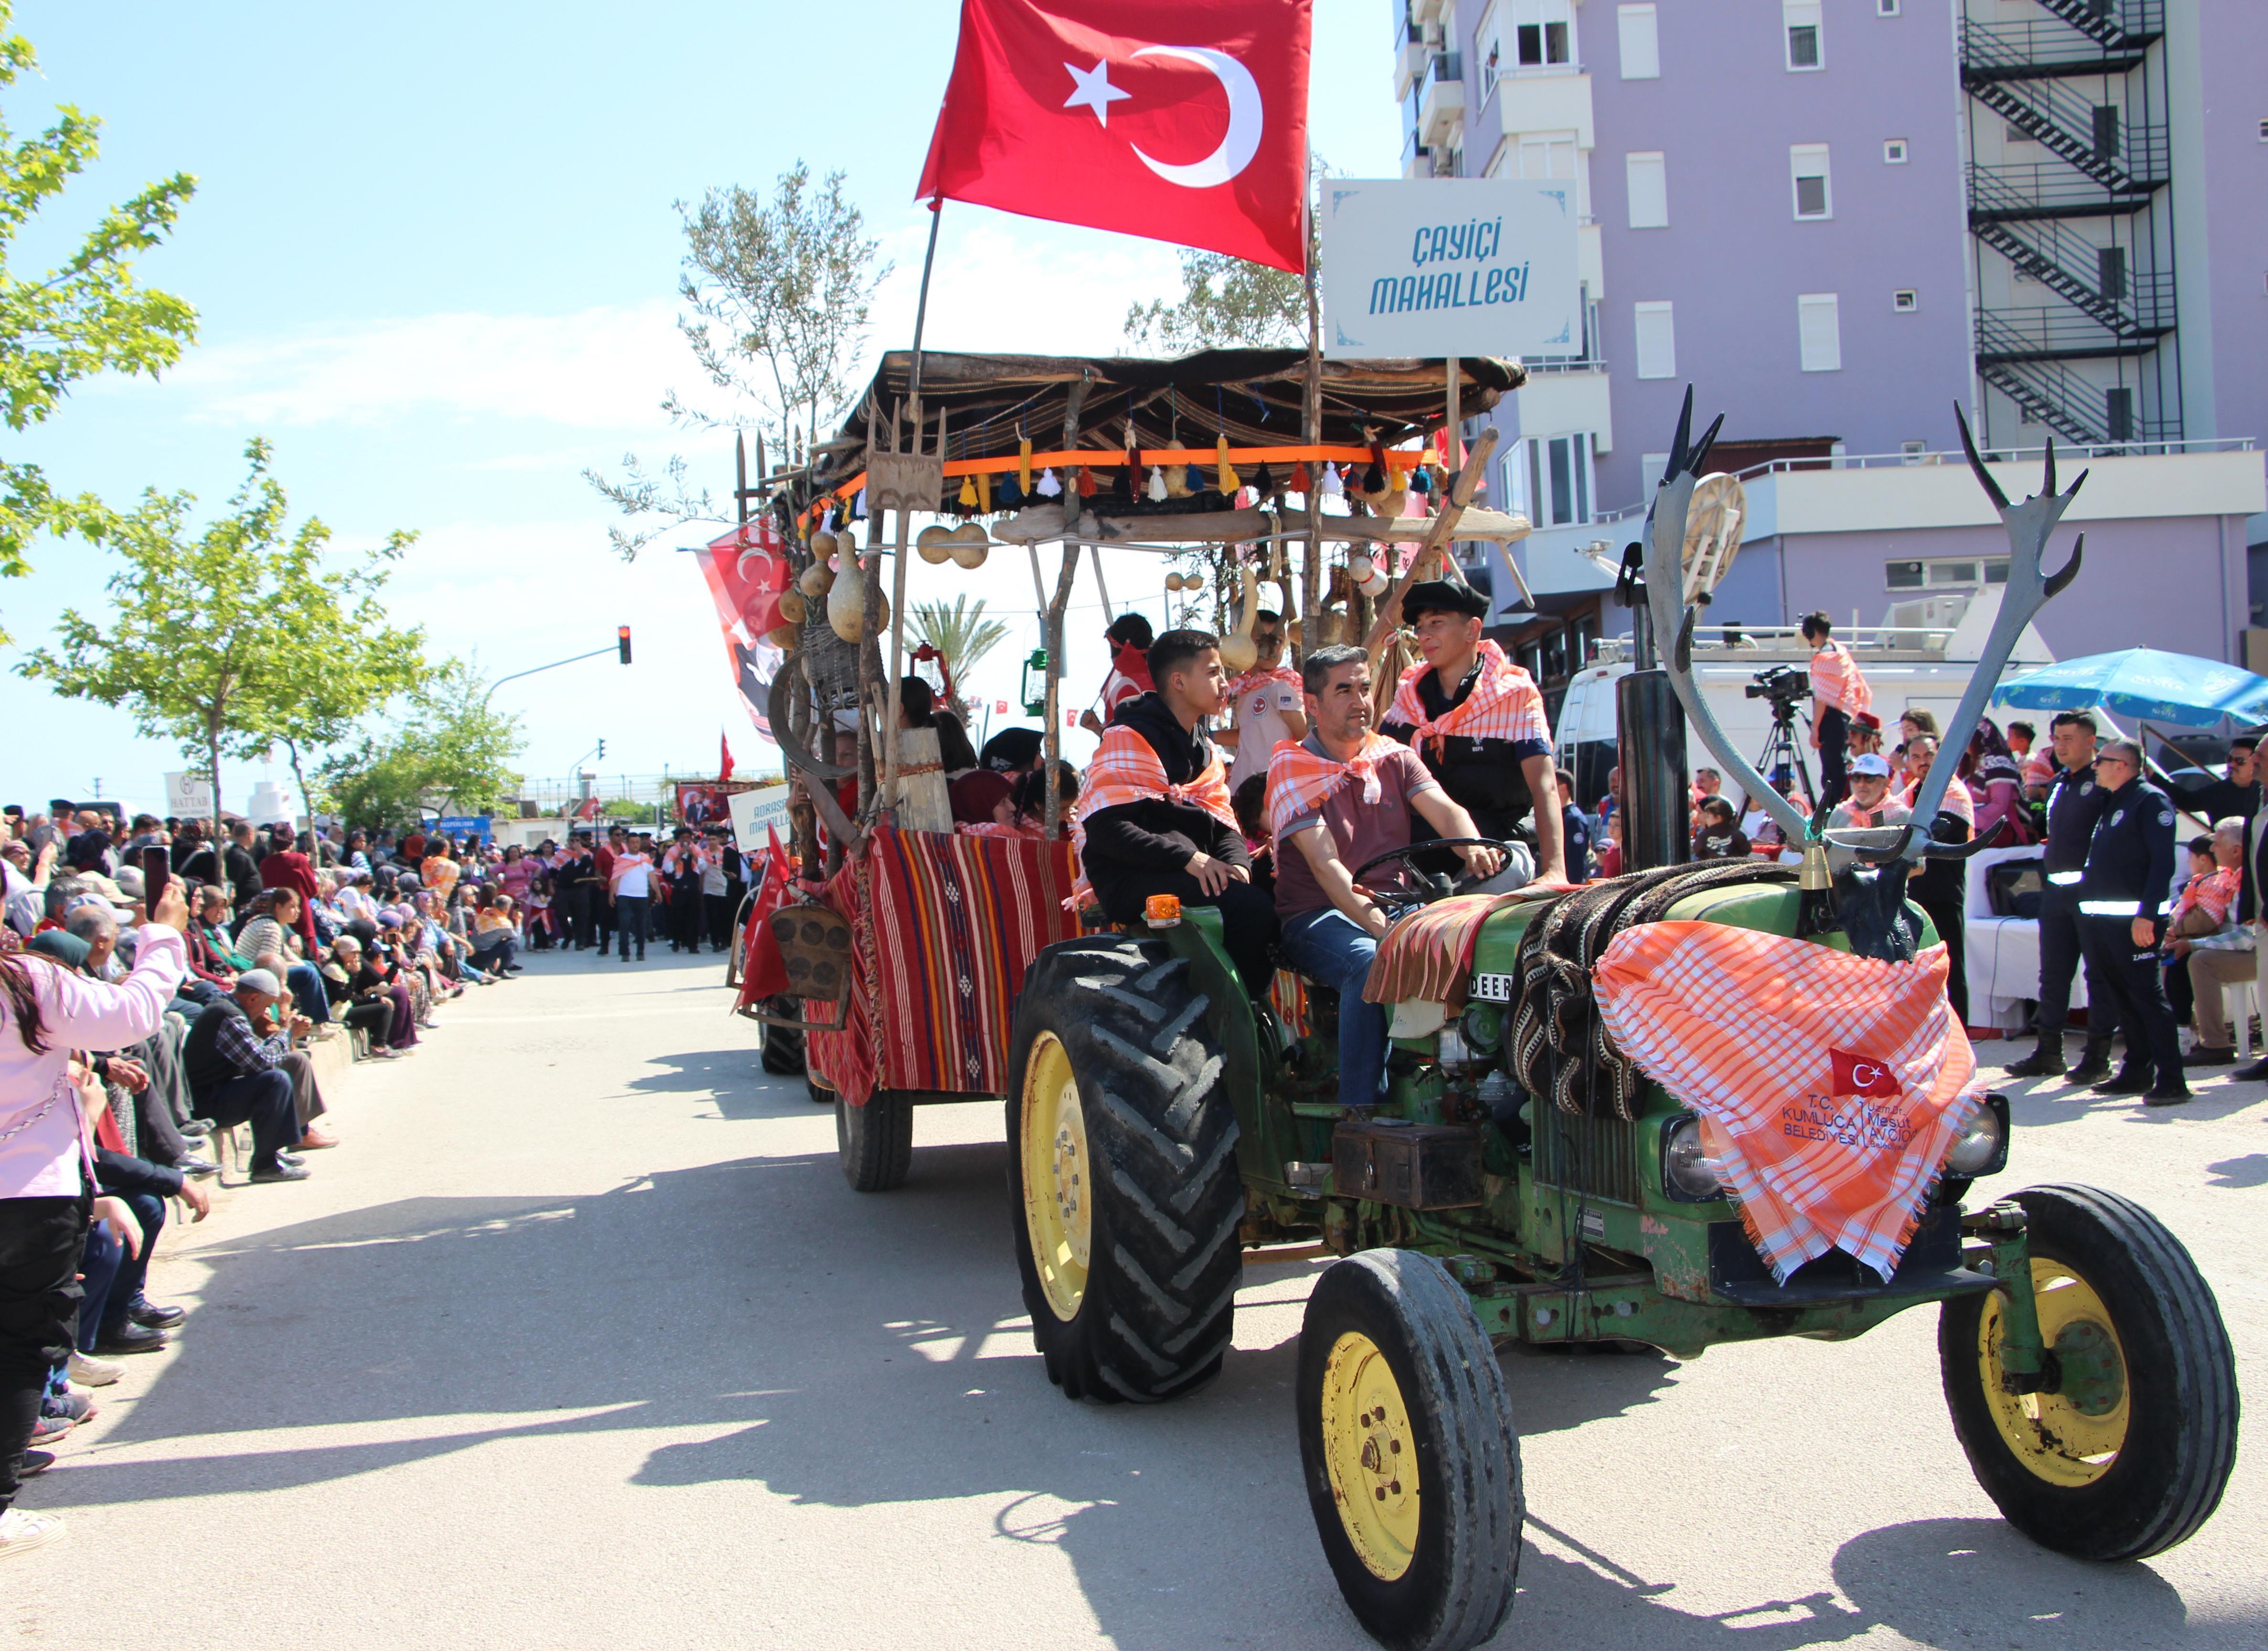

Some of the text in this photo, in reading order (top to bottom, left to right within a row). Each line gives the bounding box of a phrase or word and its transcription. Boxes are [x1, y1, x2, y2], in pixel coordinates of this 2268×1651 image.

[1412, 216, 1502, 268] ÇAYİÇİ
[171, 796, 207, 808] HATTAB
[1782, 1106, 1857, 1130] KUMLUCA
[1868, 1112, 1911, 1128] Mesut
